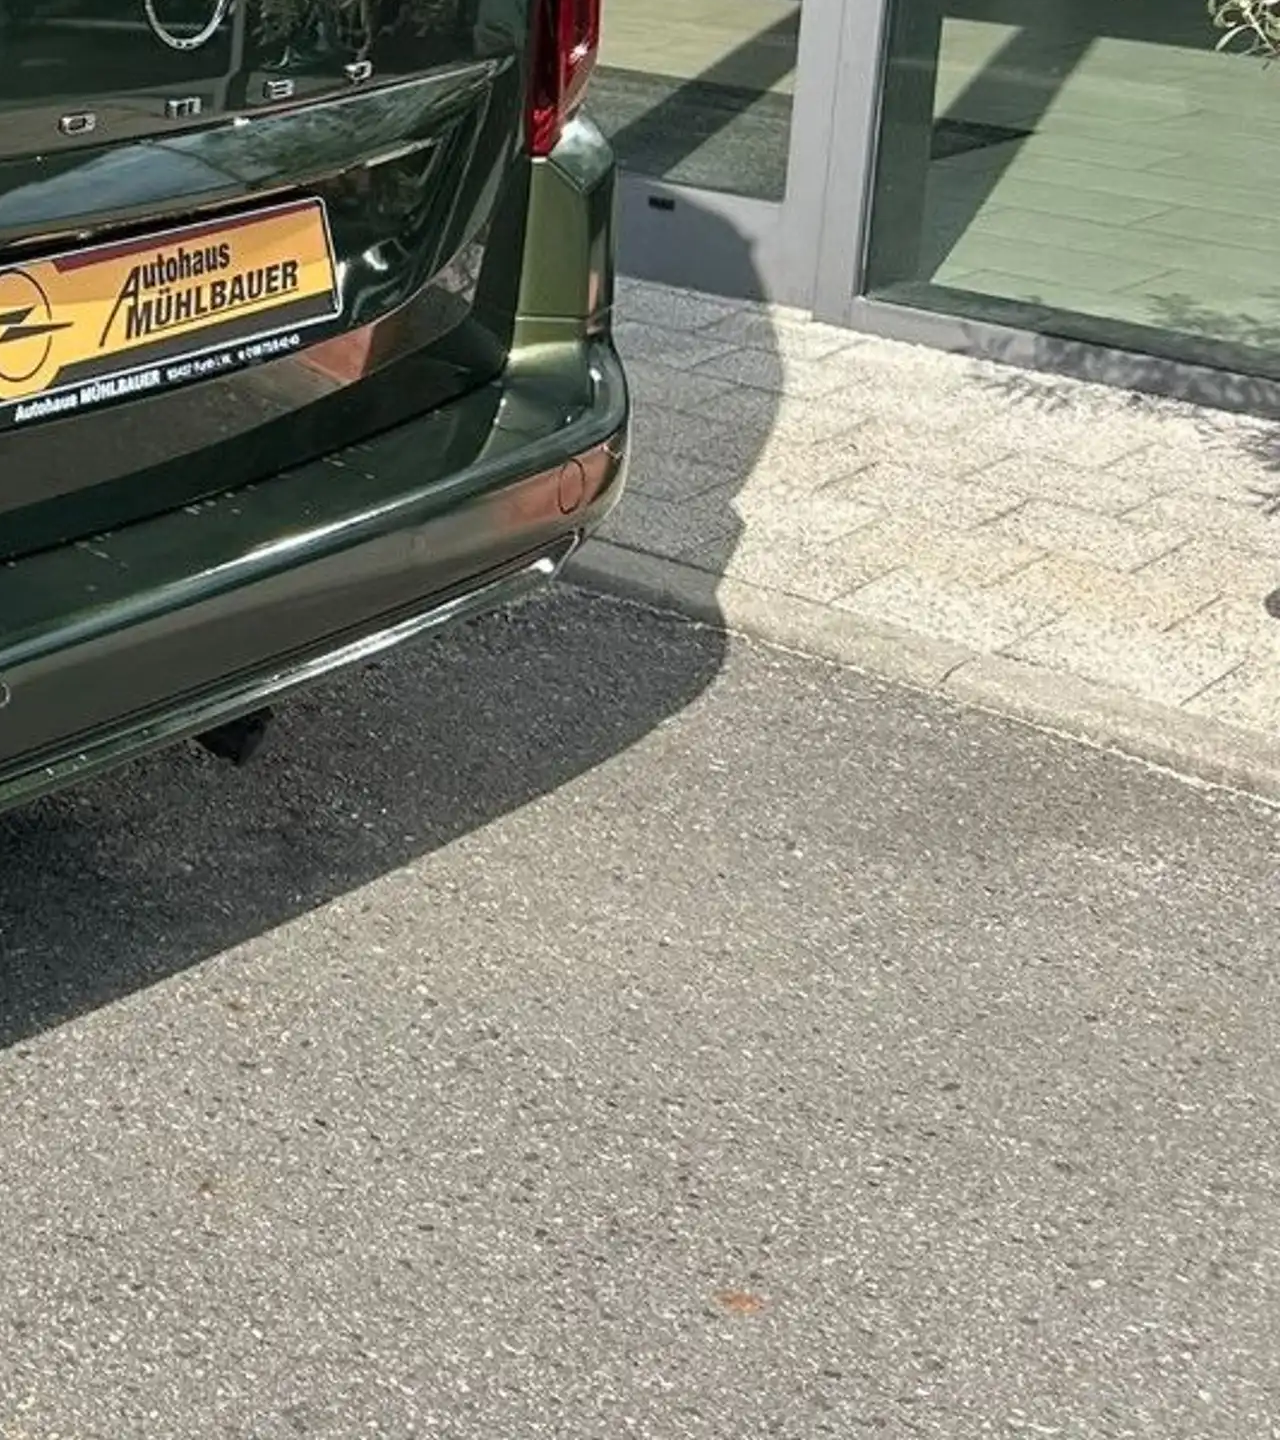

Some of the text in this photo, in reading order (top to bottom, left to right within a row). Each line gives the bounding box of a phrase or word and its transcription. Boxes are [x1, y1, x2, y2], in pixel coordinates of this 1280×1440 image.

[99, 242, 231, 347] Autohaus
[125, 259, 300, 340] MÜHLBAUER
[14, 393, 78, 422] Autohaus
[79, 369, 161, 405] MÜHLBAUER
